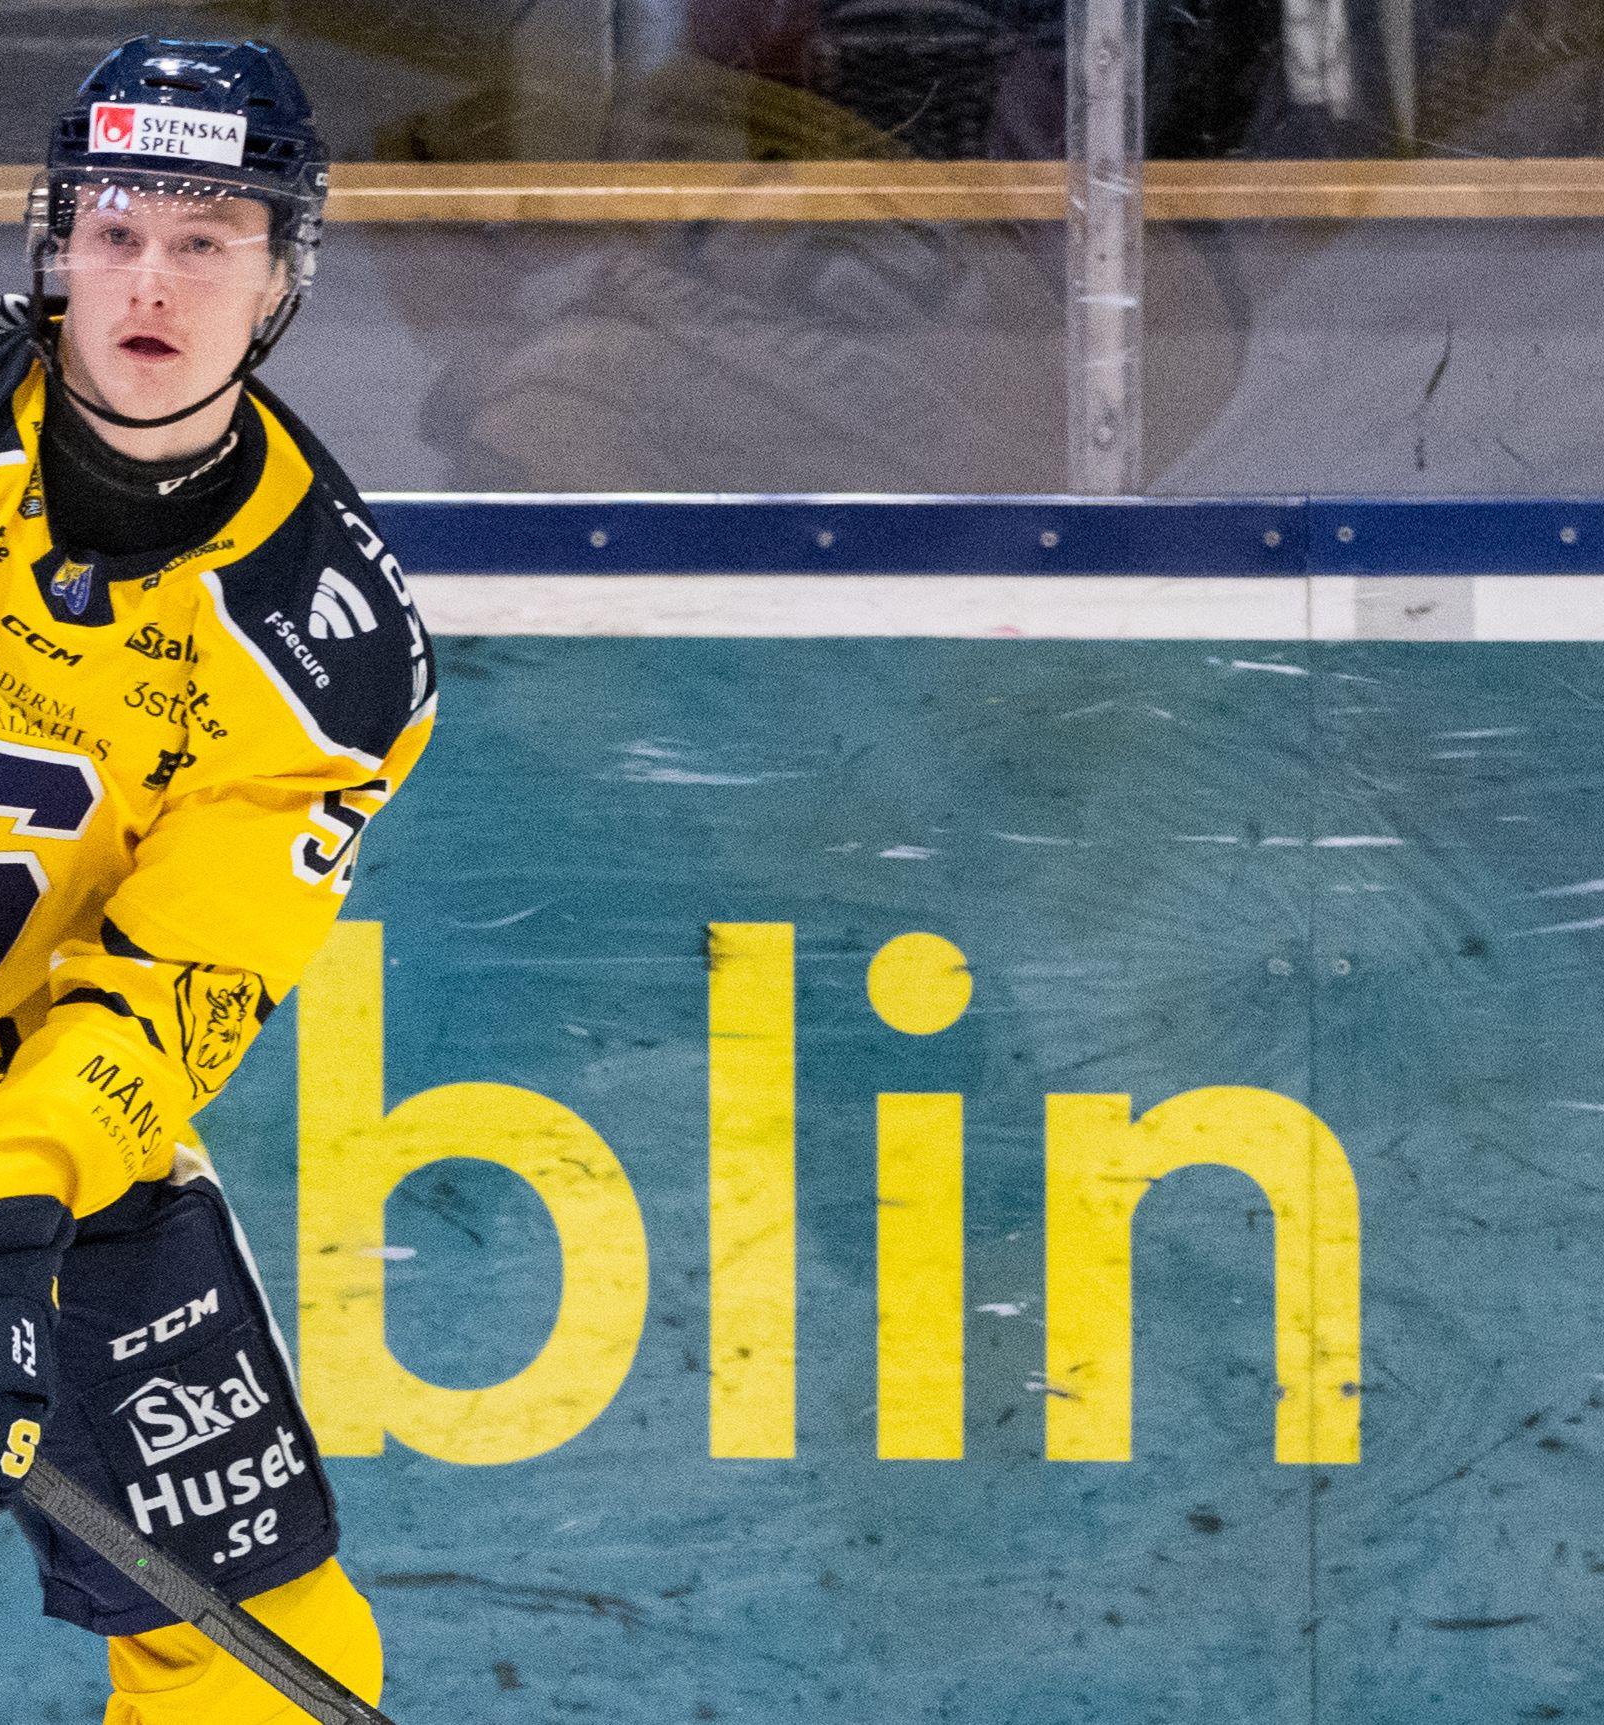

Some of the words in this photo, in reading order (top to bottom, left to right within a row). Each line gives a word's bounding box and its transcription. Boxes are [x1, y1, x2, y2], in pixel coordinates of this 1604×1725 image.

[140, 136, 191, 156] SPEL
[142, 116, 239, 143] SVENSKA
[0, 613, 84, 667] CCM
[263, 610, 331, 691] F-Secure
[291, 778, 390, 894] 5
[77, 1054, 163, 1156] MÅNS
[109, 1288, 219, 1361] CCM
[131, 1350, 270, 1449] Skal
[0, 1418, 41, 1479] S
[127, 1426, 307, 1535] Huset
[212, 1507, 279, 1565] .se
